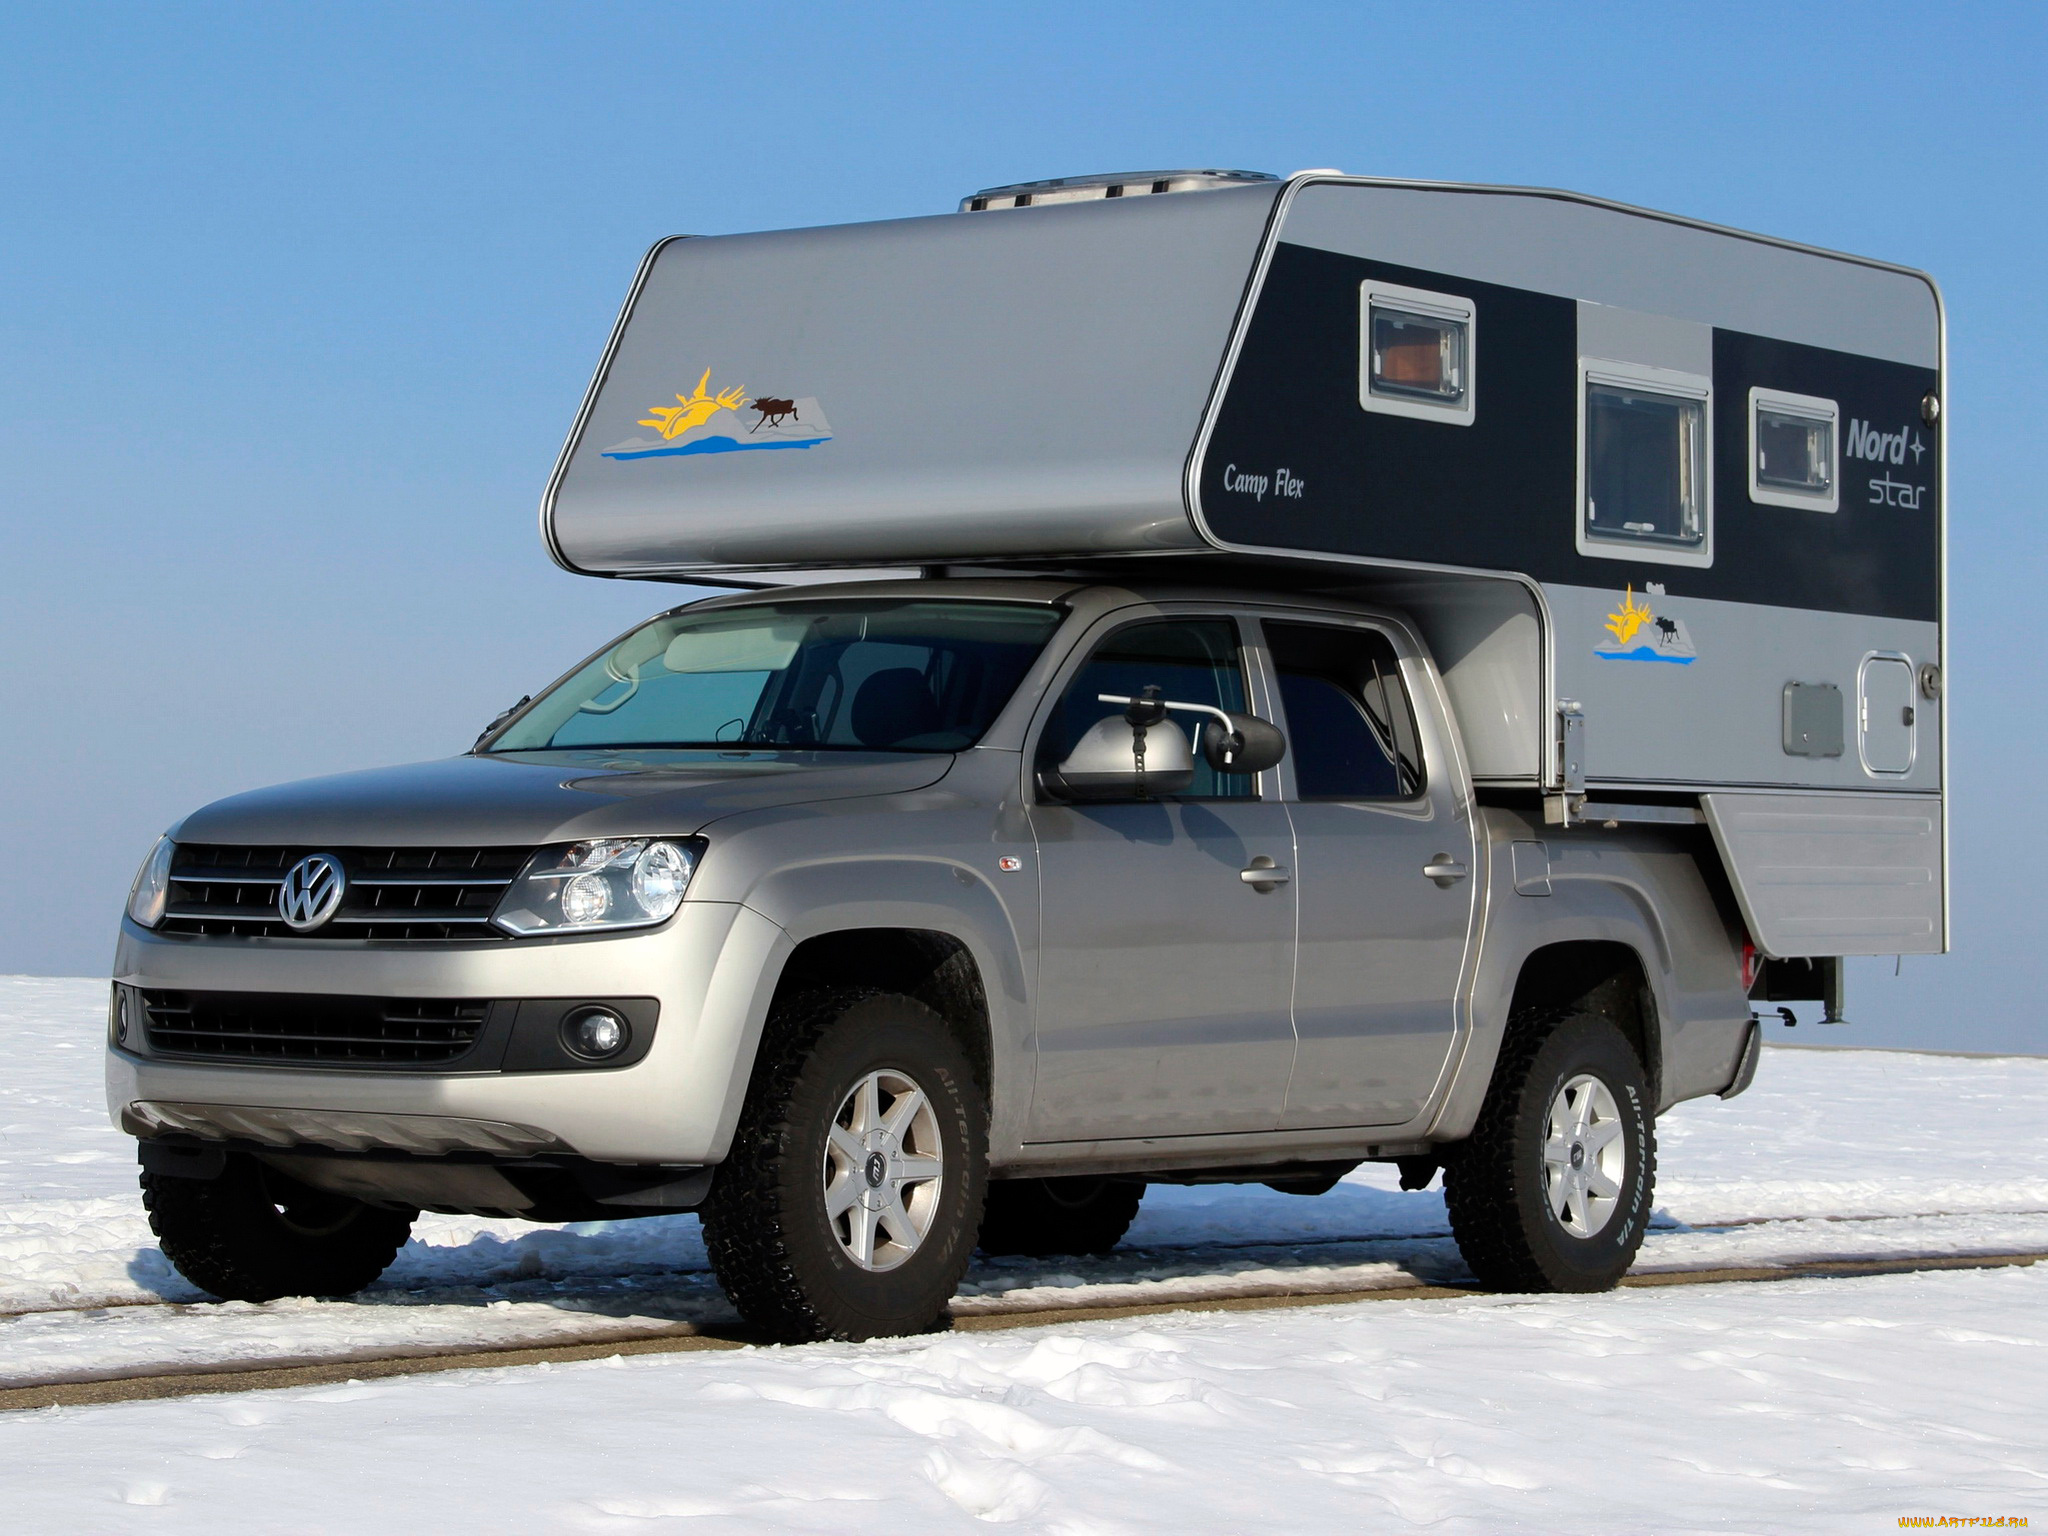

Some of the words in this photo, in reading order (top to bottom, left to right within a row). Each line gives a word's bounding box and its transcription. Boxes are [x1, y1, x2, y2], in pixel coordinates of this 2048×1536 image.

[1846, 418, 1909, 465] Nord
[1224, 463, 1268, 502] Camp
[1275, 468, 1304, 499] Flex
[1869, 471, 1926, 509] star
[1625, 1085, 1647, 1214] All-Terrain
